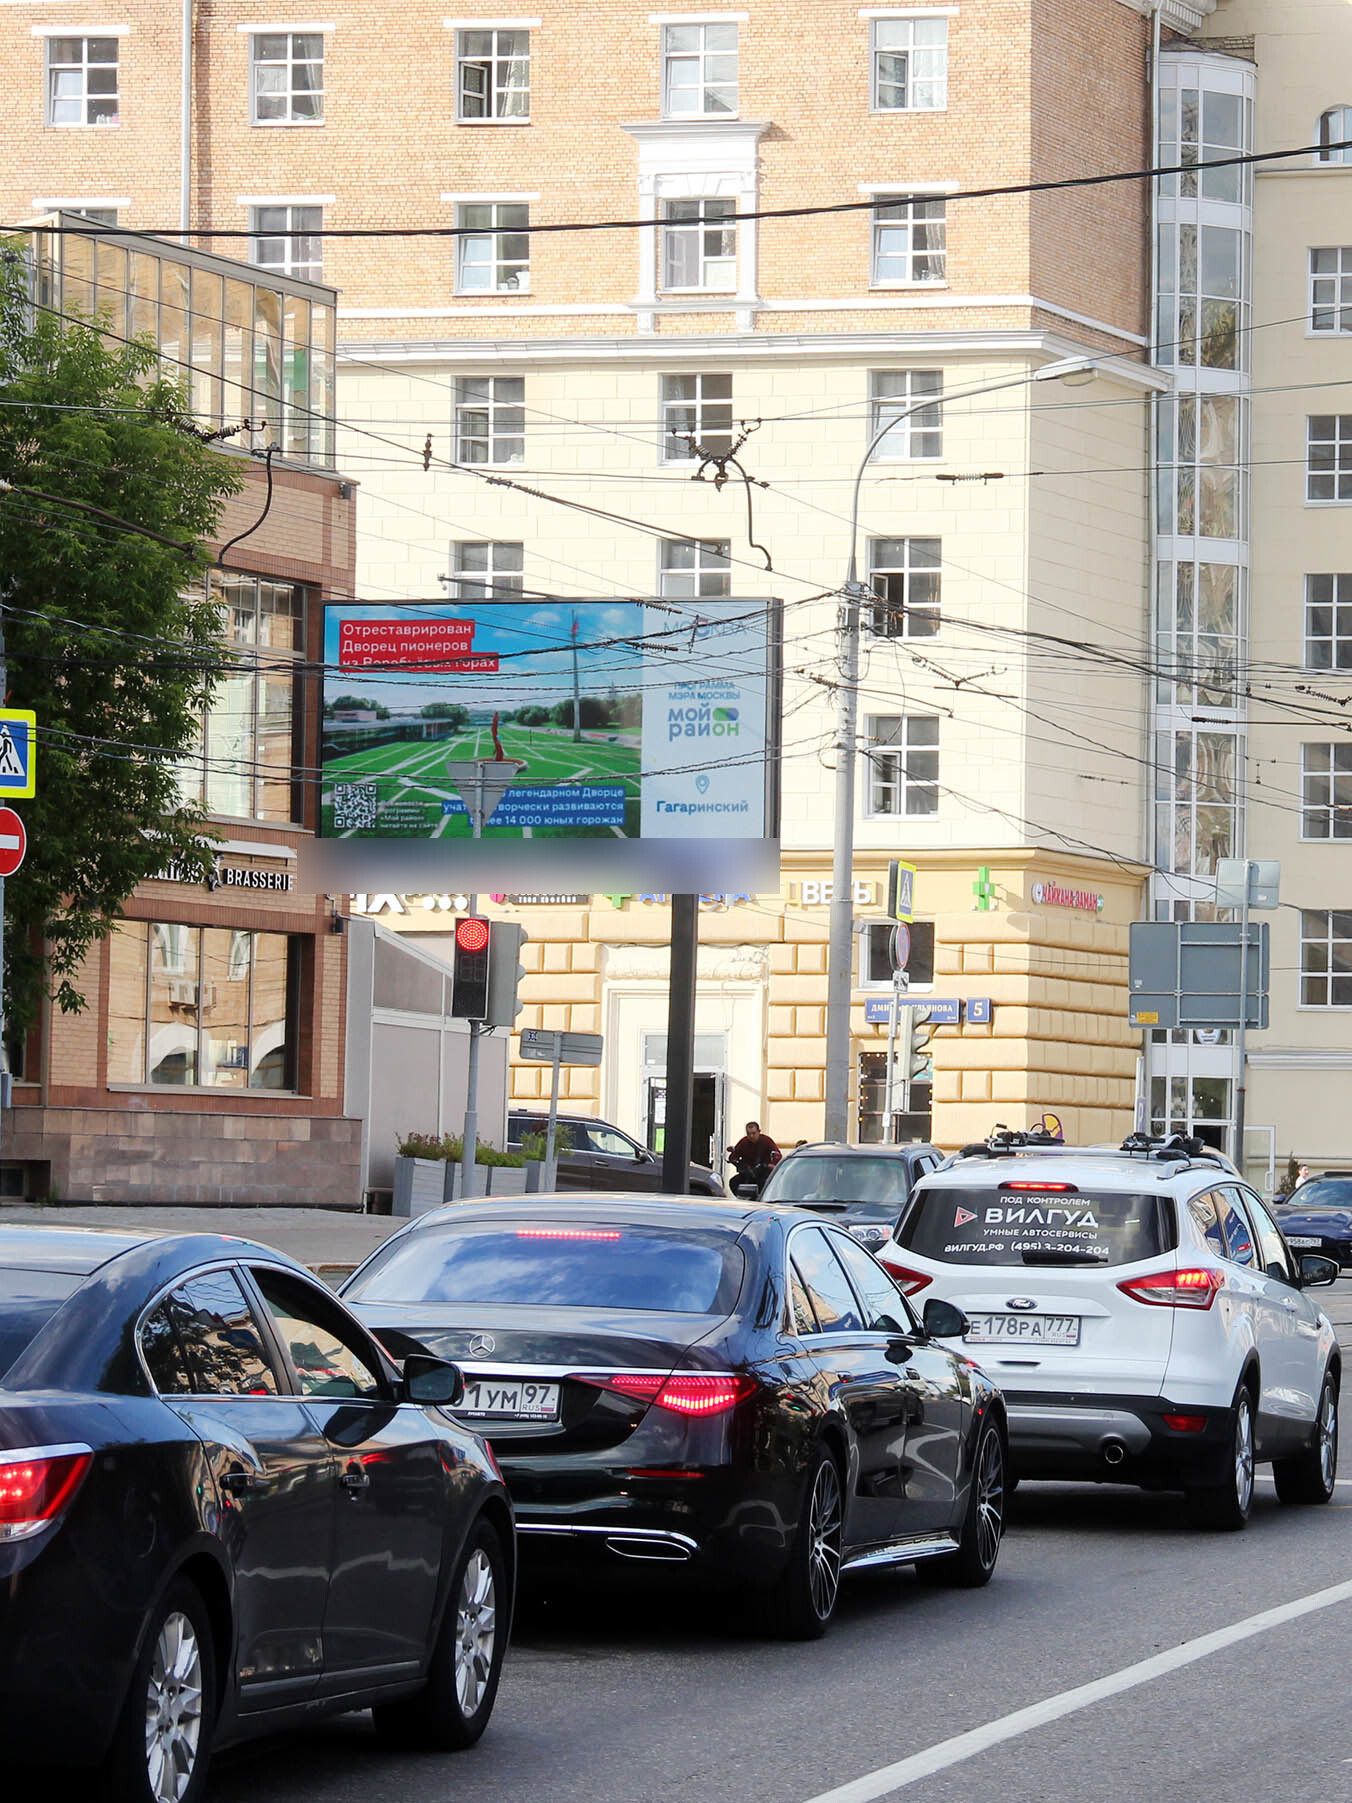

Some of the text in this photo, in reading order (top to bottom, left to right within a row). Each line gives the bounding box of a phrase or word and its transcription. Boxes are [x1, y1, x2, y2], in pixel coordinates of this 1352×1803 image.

[343, 623, 472, 637] Отреставрирован
[342, 640, 468, 653] Дворец пионеров
[668, 691, 741, 700] МЭРА МОСКВЫ
[668, 702, 711, 721] мой
[509, 789, 580, 799] легендарном
[582, 788, 624, 799] Дворце
[552, 803, 624, 813] развиваются
[656, 800, 748, 815] Гагаринский
[505, 816, 517, 825] 14
[519, 816, 540, 825] 000
[544, 817, 573, 825] юных
[576, 817, 623, 826] горожан
[227, 868, 294, 891] BRASSERIE
[784, 880, 878, 910] ЦВЕЫ
[973, 1002, 984, 1017] 5
[1000, 1196, 1091, 1207] ПОД КОНТРОЛЕМ
[984, 1207, 1099, 1228] ВИЛГУД
[983, 1228, 1098, 1240] УМНЫЕ АВТОСЕРВИСЫ
[944, 1243, 1005, 1253] ВИЛГУД.РФ
[1011, 1241, 1042, 1252] (495)
[1046, 1317, 1074, 1332] 777
[525, 1385, 551, 1404] 97
[522, 1404, 540, 1412] RUS
